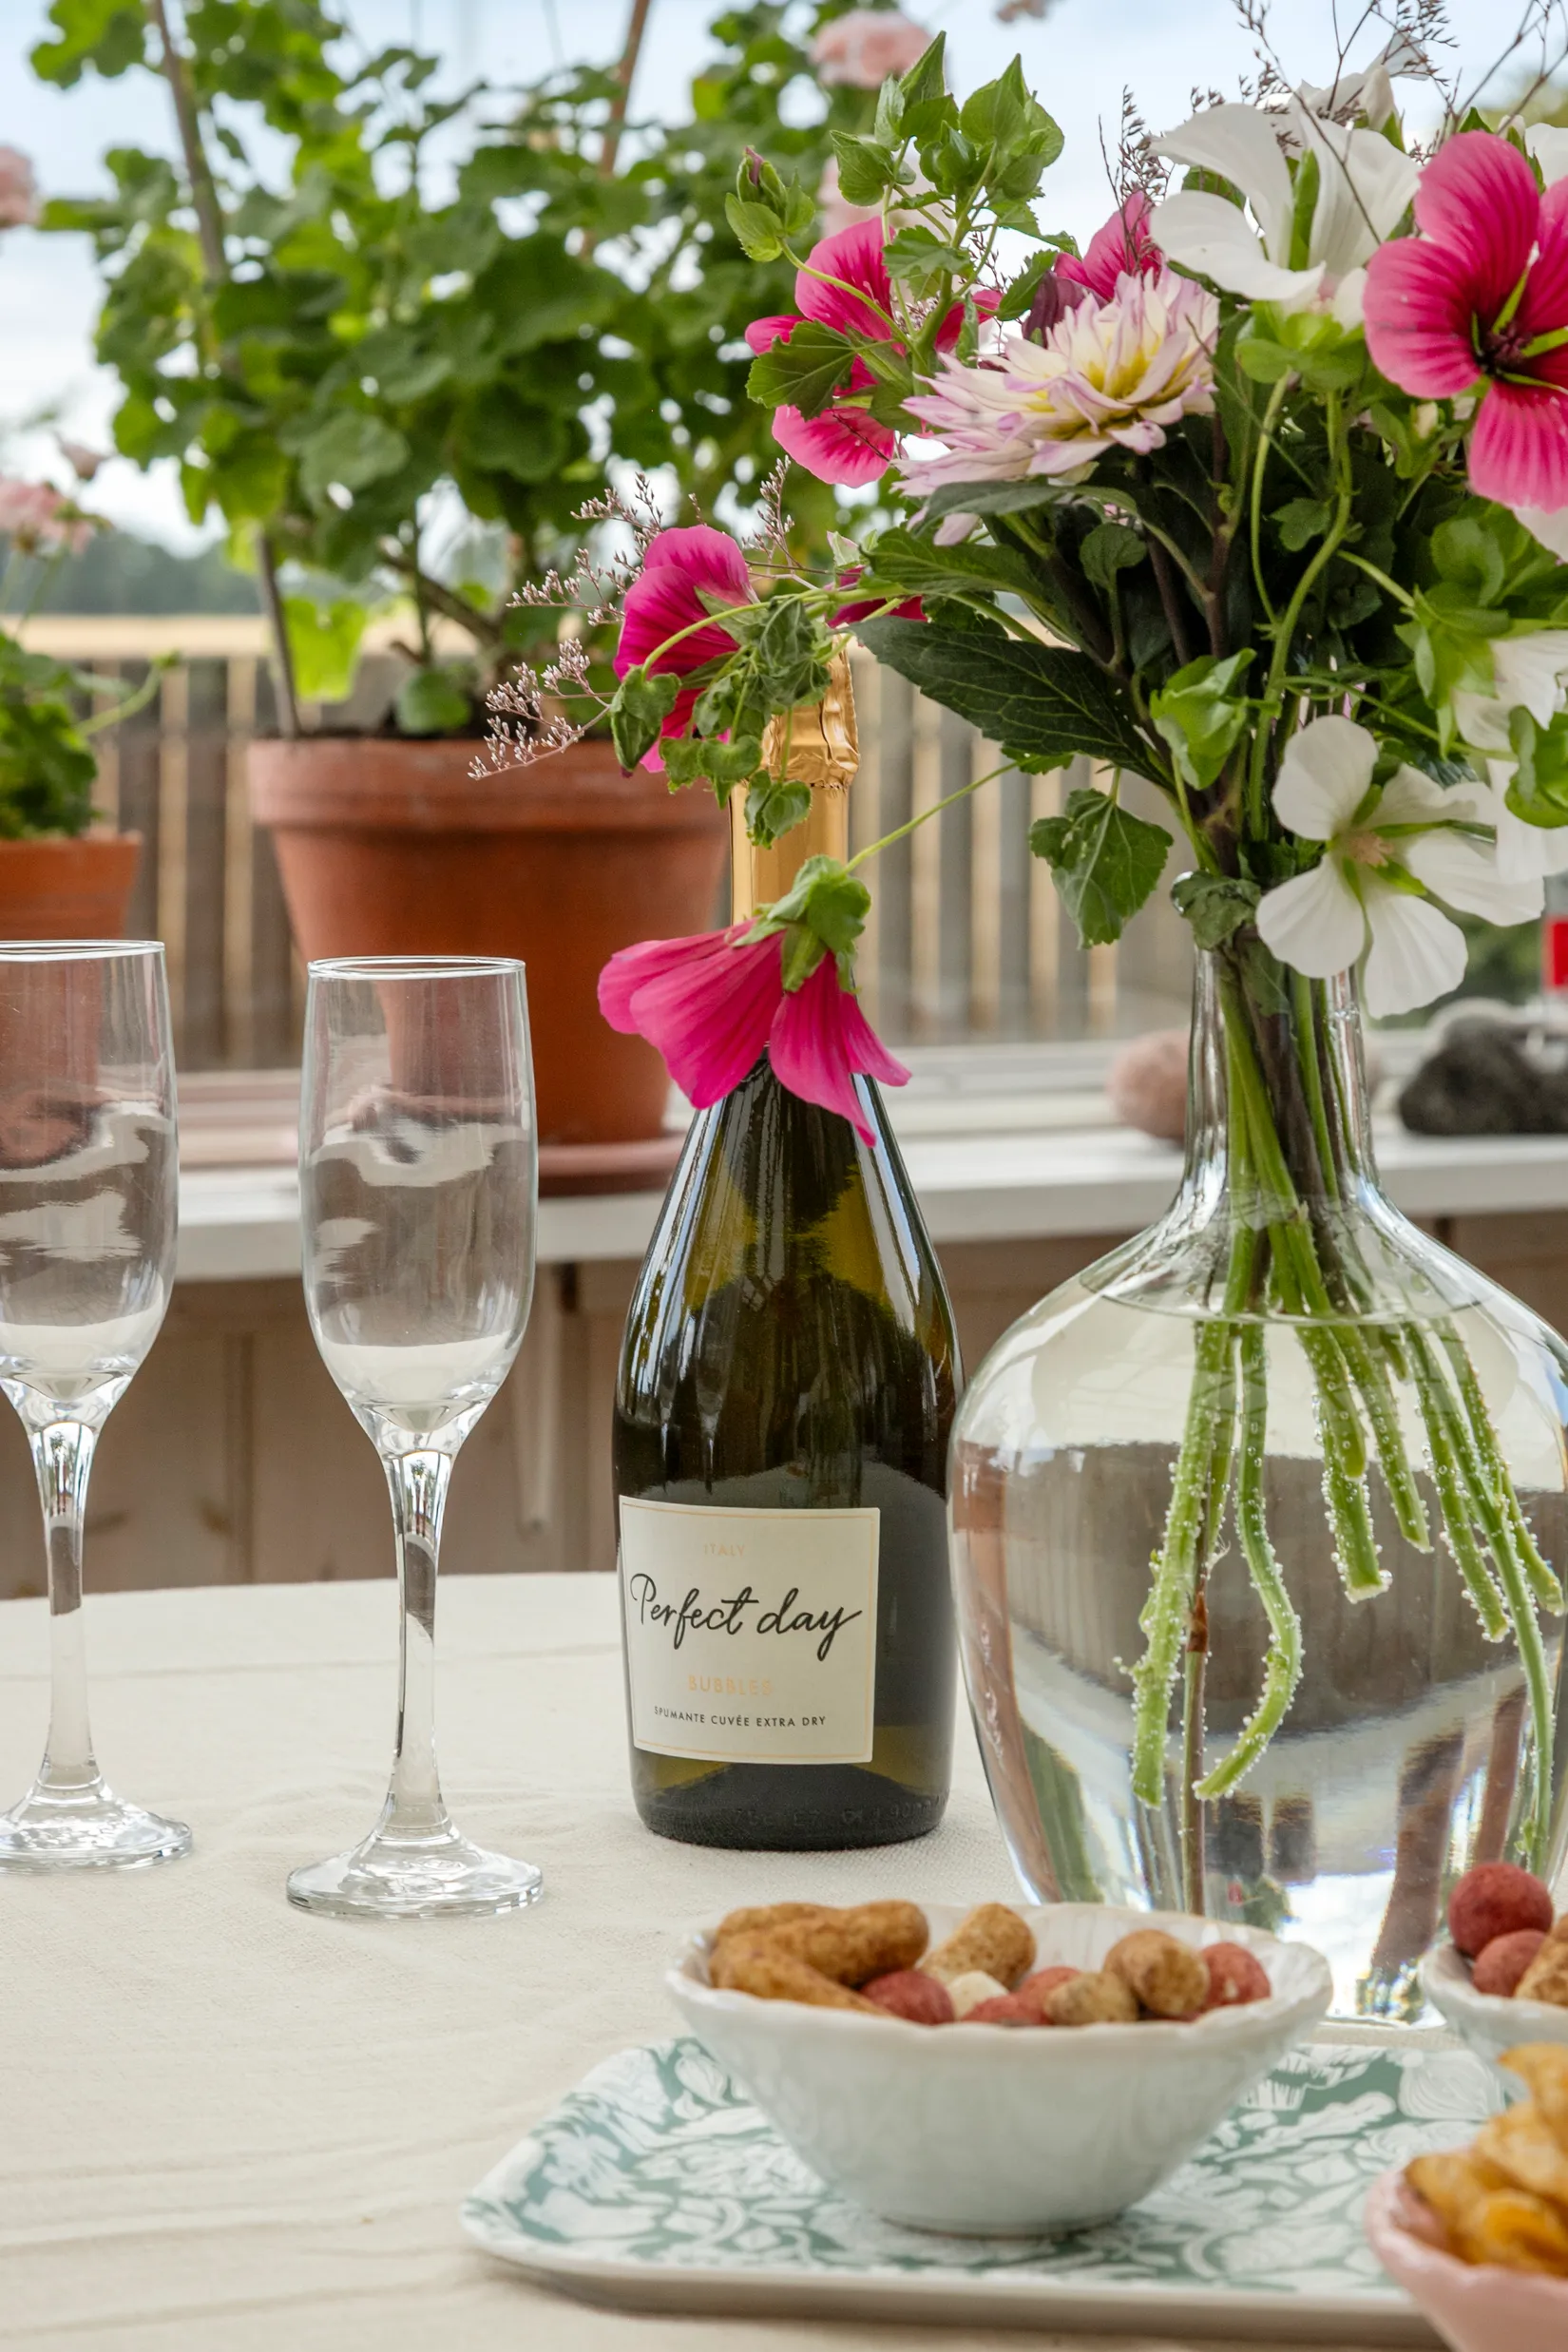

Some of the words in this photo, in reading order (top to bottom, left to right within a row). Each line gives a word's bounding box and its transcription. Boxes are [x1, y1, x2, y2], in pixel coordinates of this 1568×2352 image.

[703, 1543, 745, 1557] ITALY
[630, 1573, 759, 1650] Perfect
[756, 1588, 863, 1661] day
[688, 1673, 774, 1696] BUBBLES
[654, 1705, 705, 1724] SPUMANTE
[711, 1713, 750, 1727] CUVÉE
[756, 1717, 795, 1728] EXTRA
[802, 1716, 827, 1726] DRY
